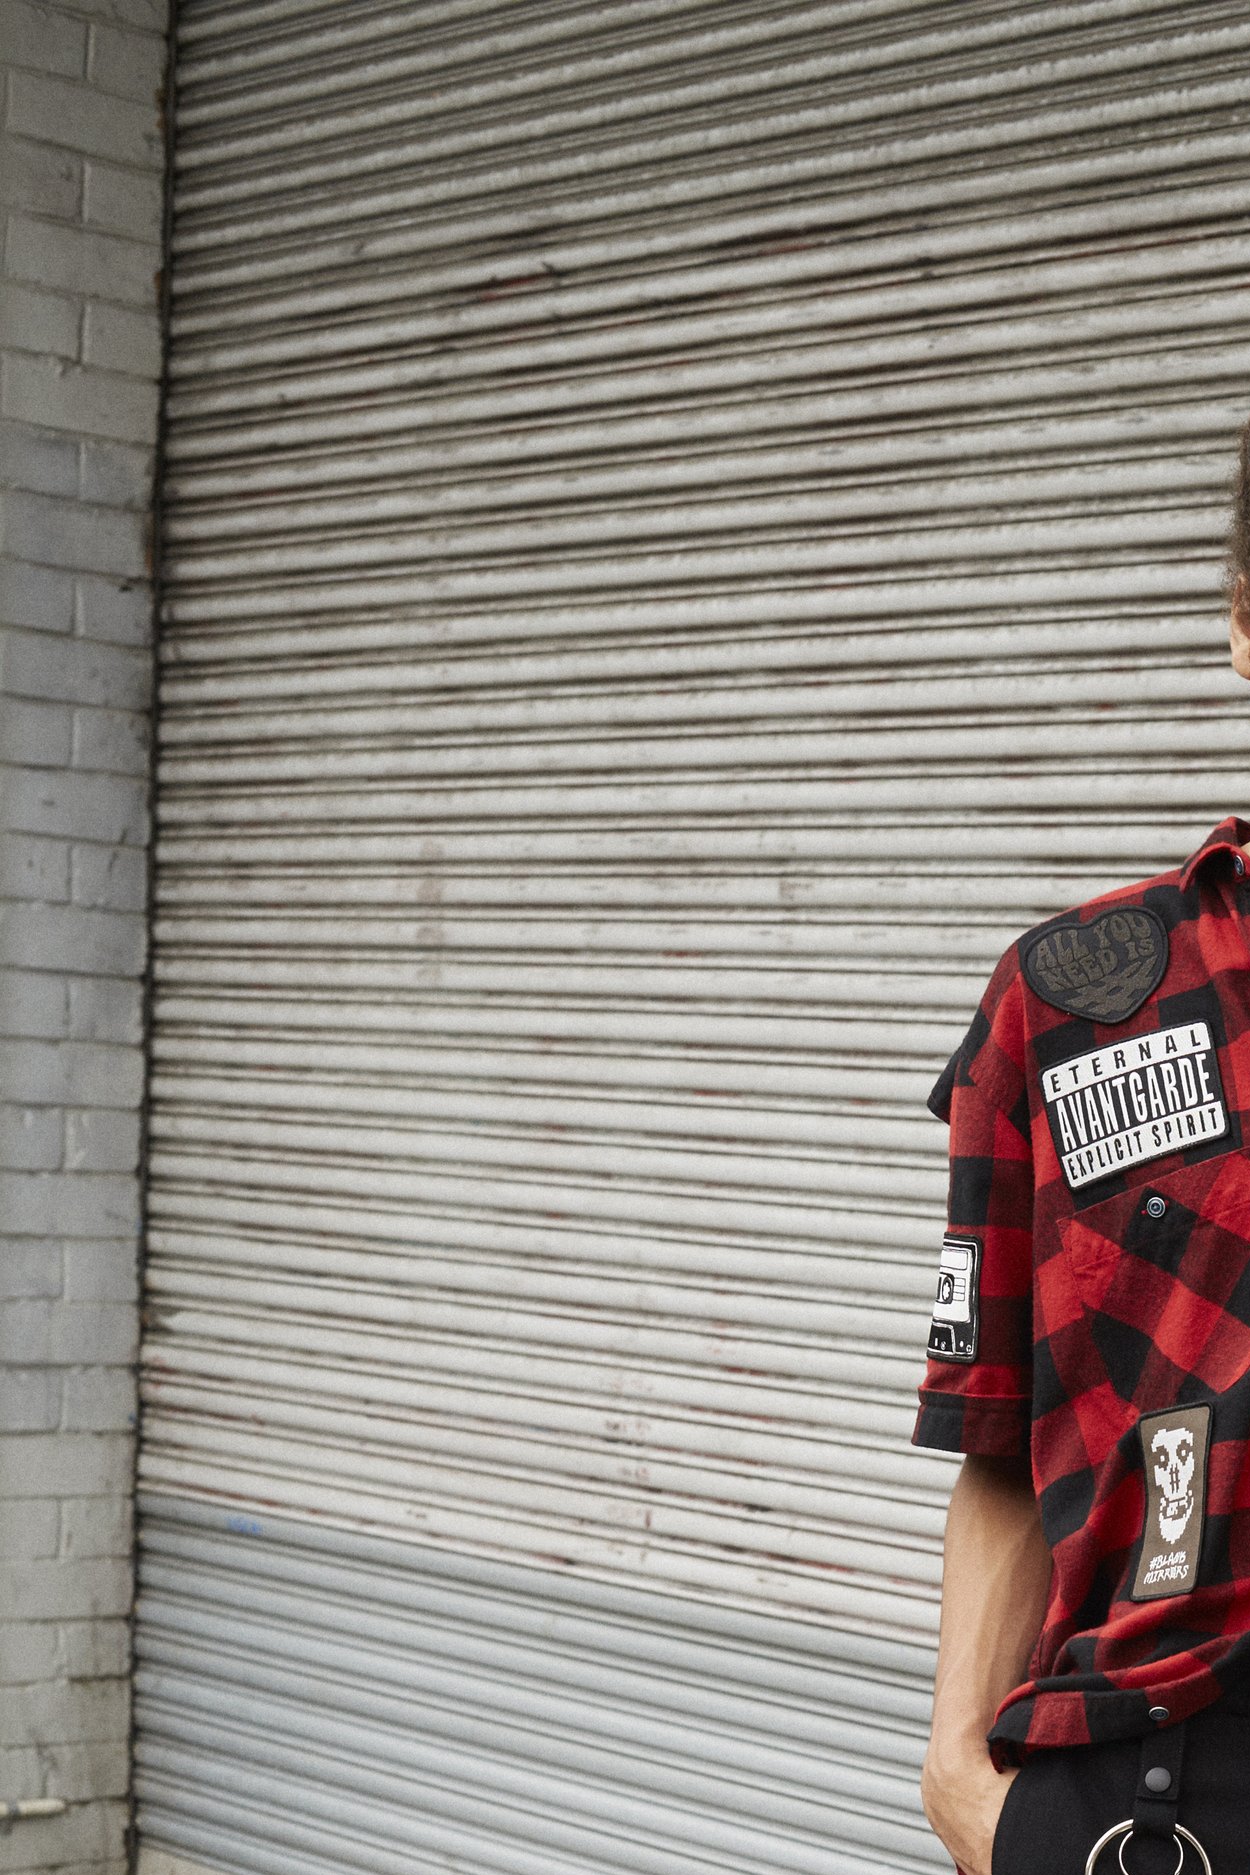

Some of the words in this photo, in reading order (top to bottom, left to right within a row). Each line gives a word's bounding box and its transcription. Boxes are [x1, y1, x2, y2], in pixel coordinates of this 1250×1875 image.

[1035, 929, 1090, 970] ALL
[1093, 911, 1152, 949] YOU
[1037, 948, 1119, 992] NEED
[1125, 937, 1155, 962] IS
[1050, 1028, 1201, 1094] ETERNAL
[1055, 1052, 1215, 1153] AVANTGARDE
[1068, 1130, 1142, 1181] EXPLICIT
[1151, 1107, 1218, 1148] SPIRIT
[1143, 1564, 1190, 1585] MIRRORS
[1149, 1550, 1186, 1571] #BLACK
